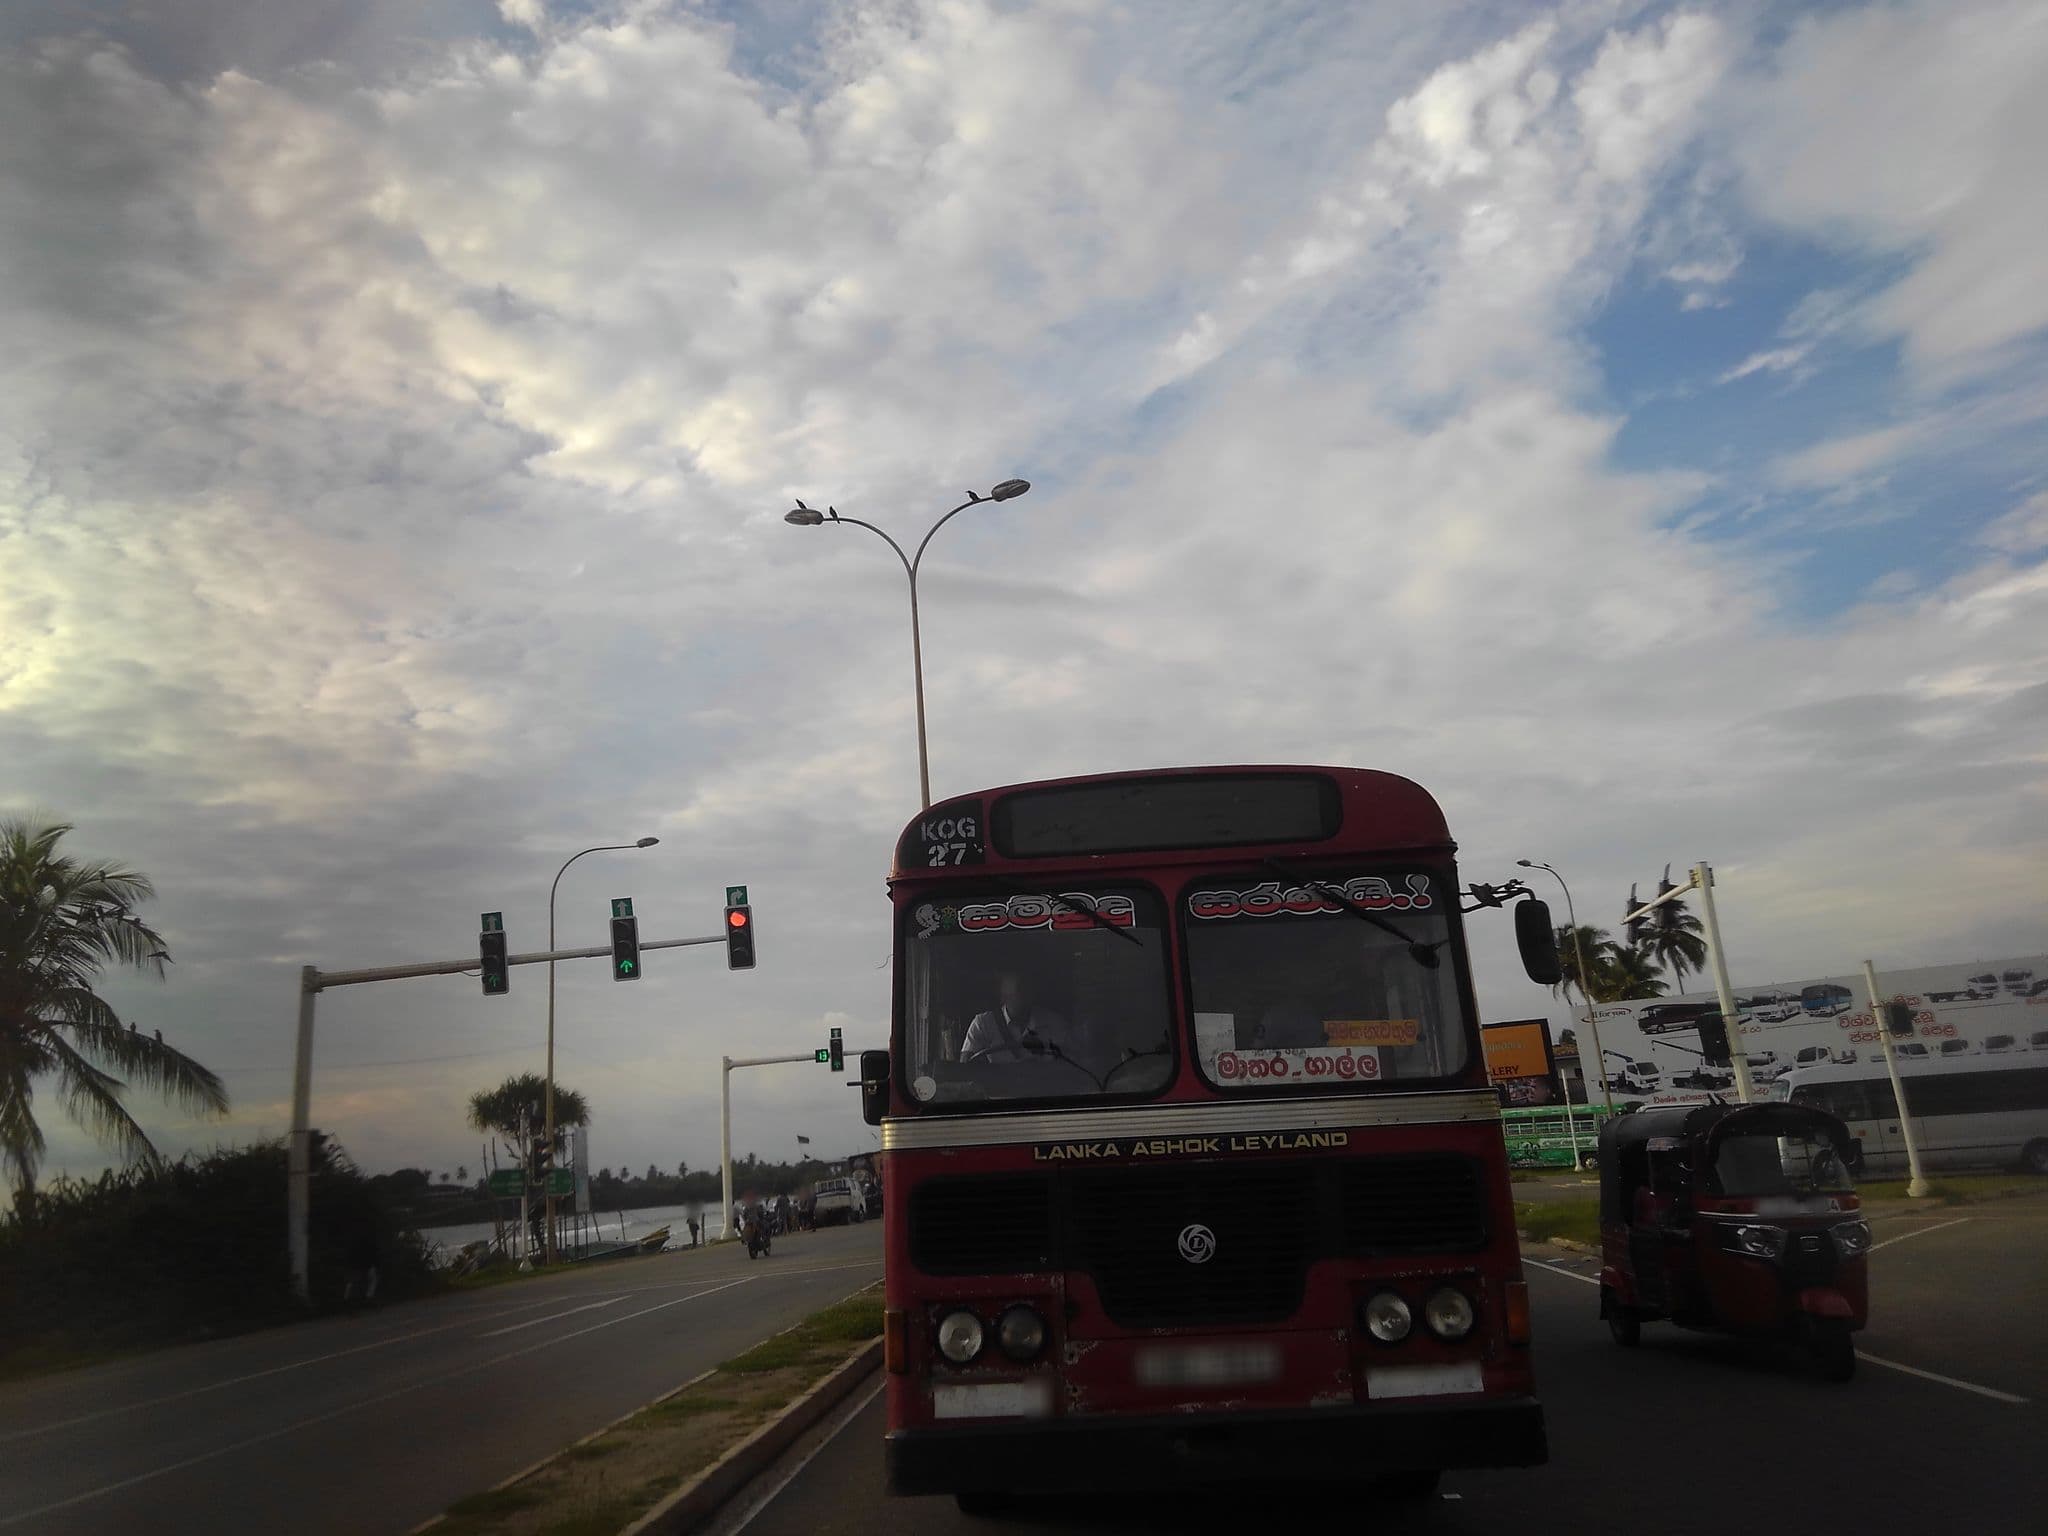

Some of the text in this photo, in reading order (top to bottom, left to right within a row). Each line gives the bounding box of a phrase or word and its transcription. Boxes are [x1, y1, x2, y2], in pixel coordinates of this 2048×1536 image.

[920, 816, 976, 841] KOG
[928, 843, 967, 867] 27
[819, 1050, 828, 1061] 13
[1217, 1051, 1289, 1080] මාතර
[1305, 1048, 1378, 1080] ගාල්ල
[1032, 1131, 1350, 1162] LANKA ASHOK LEYLAND
